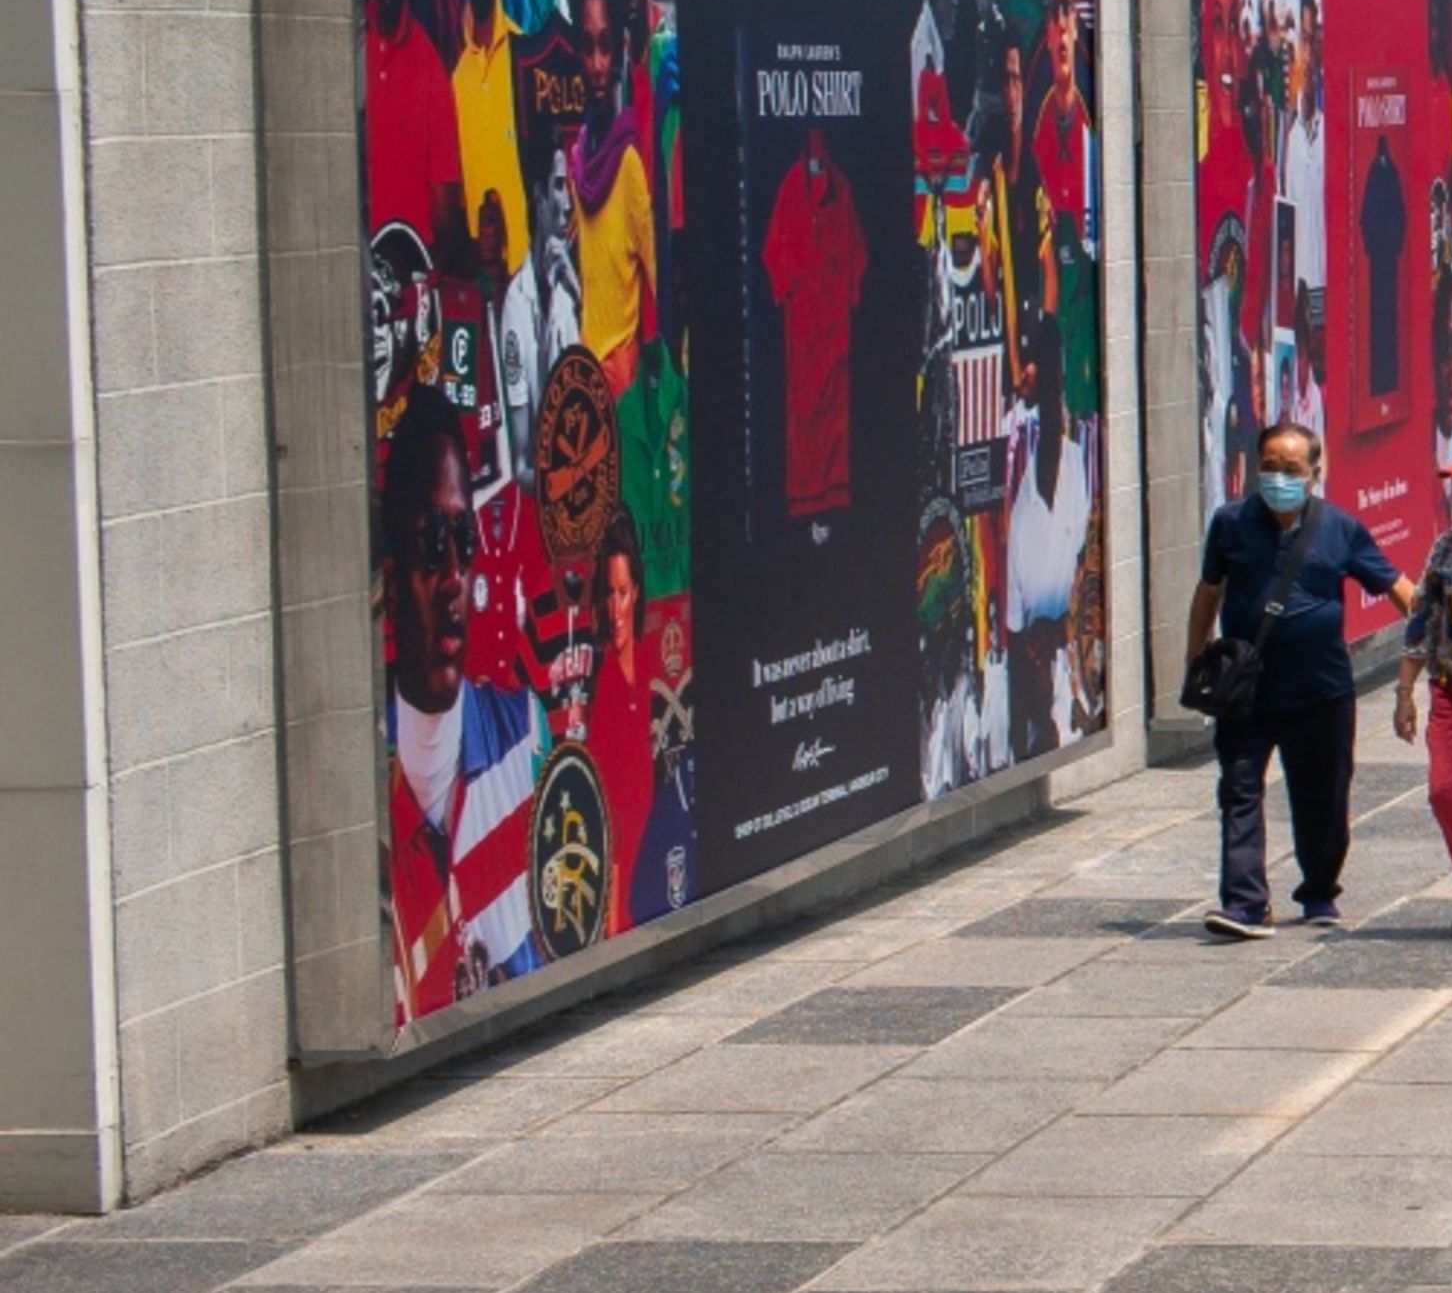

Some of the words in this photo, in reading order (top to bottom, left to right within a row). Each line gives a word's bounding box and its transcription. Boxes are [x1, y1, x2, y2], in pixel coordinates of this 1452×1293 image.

[532, 66, 587, 117] POLO
[757, 70, 808, 117] POLO
[812, 70, 863, 117] SHIRT
